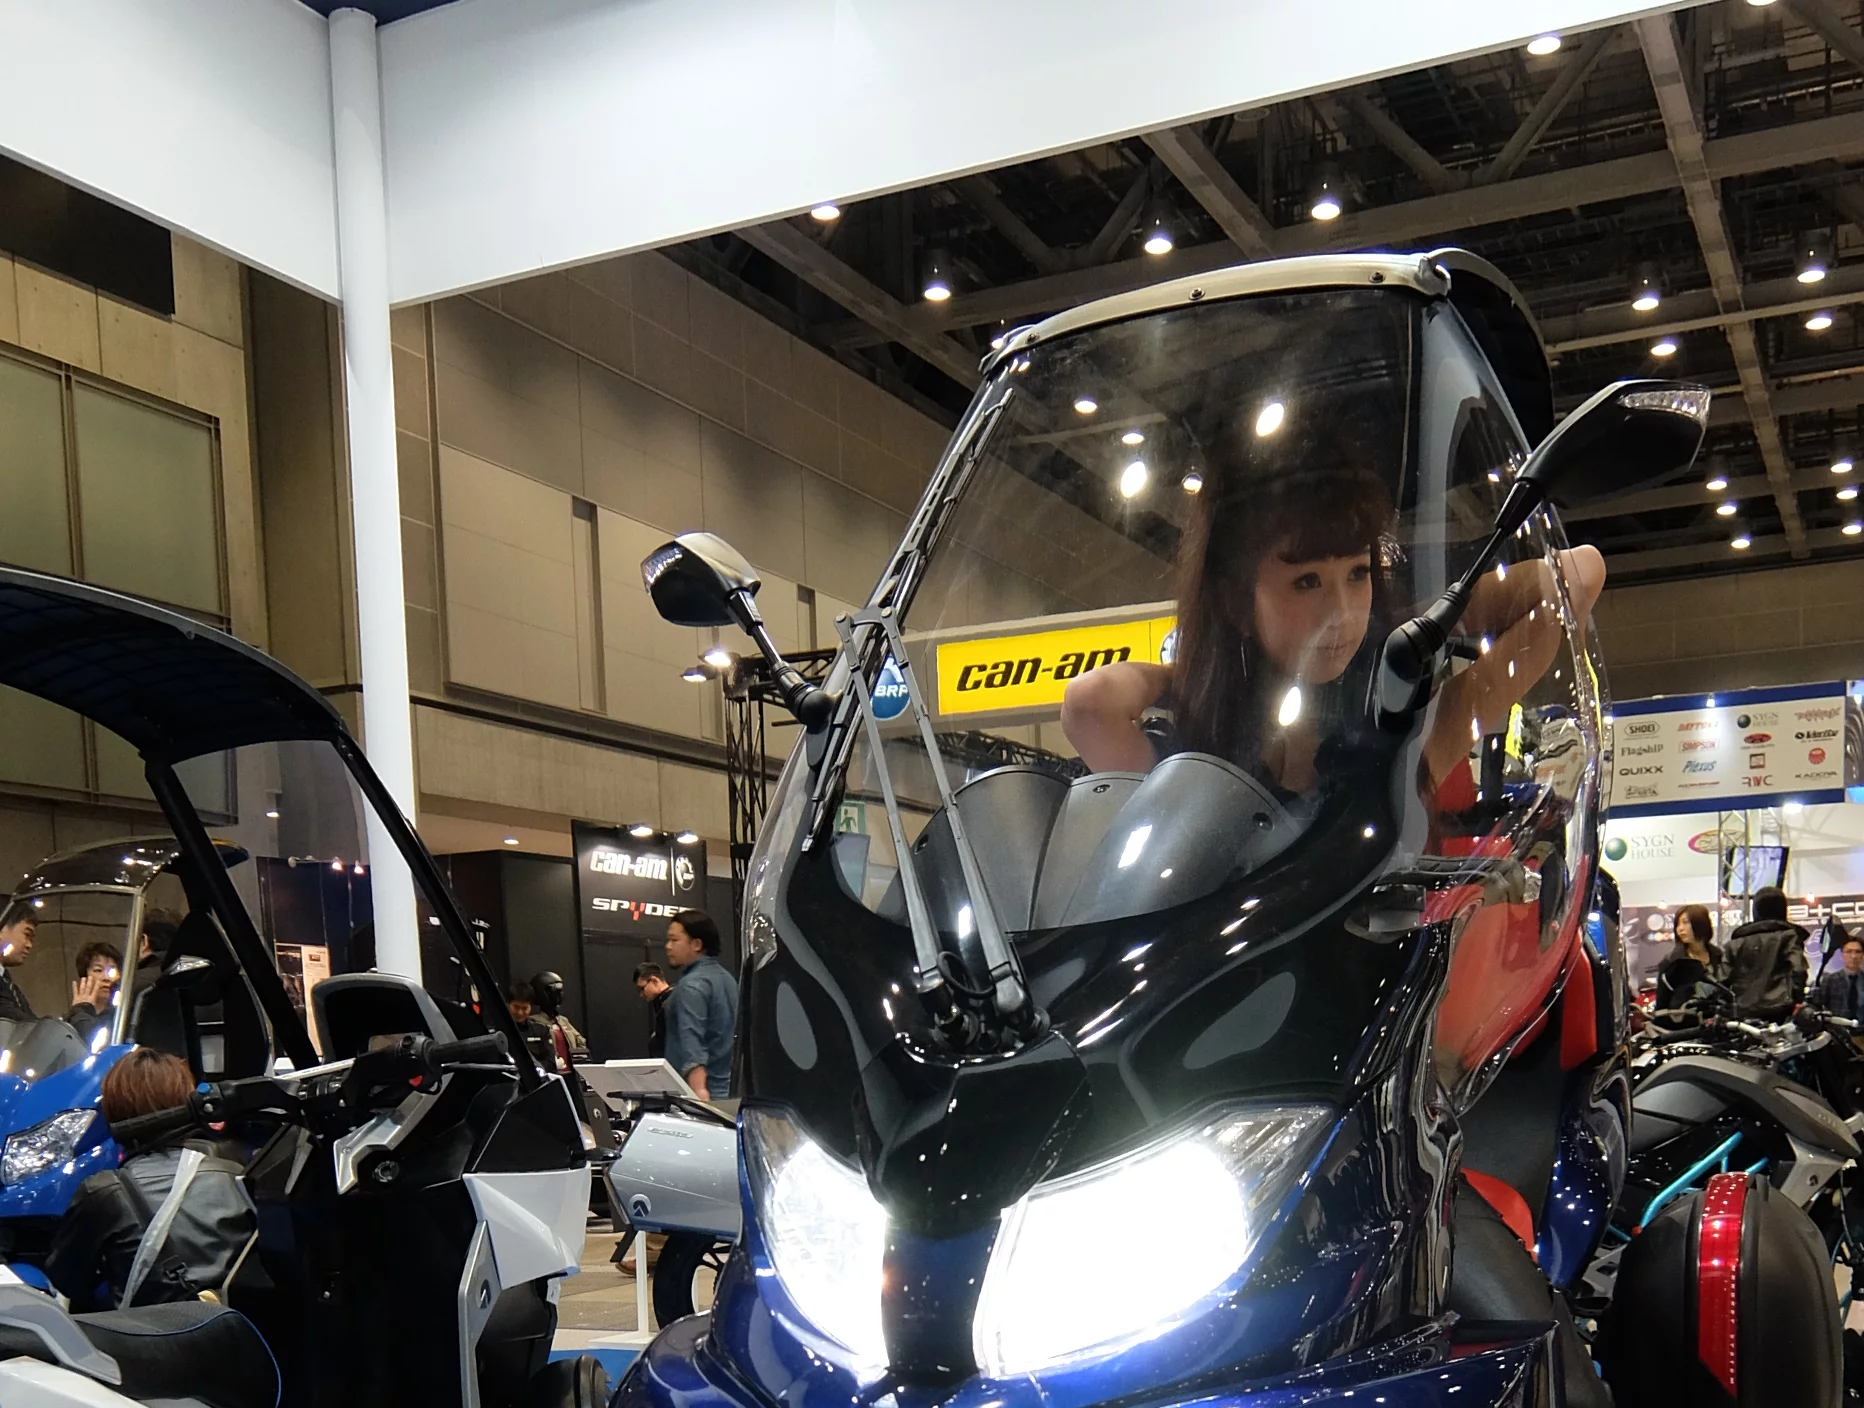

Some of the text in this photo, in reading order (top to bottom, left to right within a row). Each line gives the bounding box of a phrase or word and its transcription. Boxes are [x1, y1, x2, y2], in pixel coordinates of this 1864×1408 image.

[956, 646, 1131, 692] can-am
[874, 684, 909, 698] BRP
[1629, 723, 1656, 734] SHOEI
[1677, 721, 1719, 732] DAYTO
[1619, 765, 1664, 776] QUIXX
[1631, 833, 1675, 848] SYGN
[1631, 847, 1676, 860] HOUSE
[590, 850, 668, 881] can-am
[592, 897, 697, 921] SPYDE
